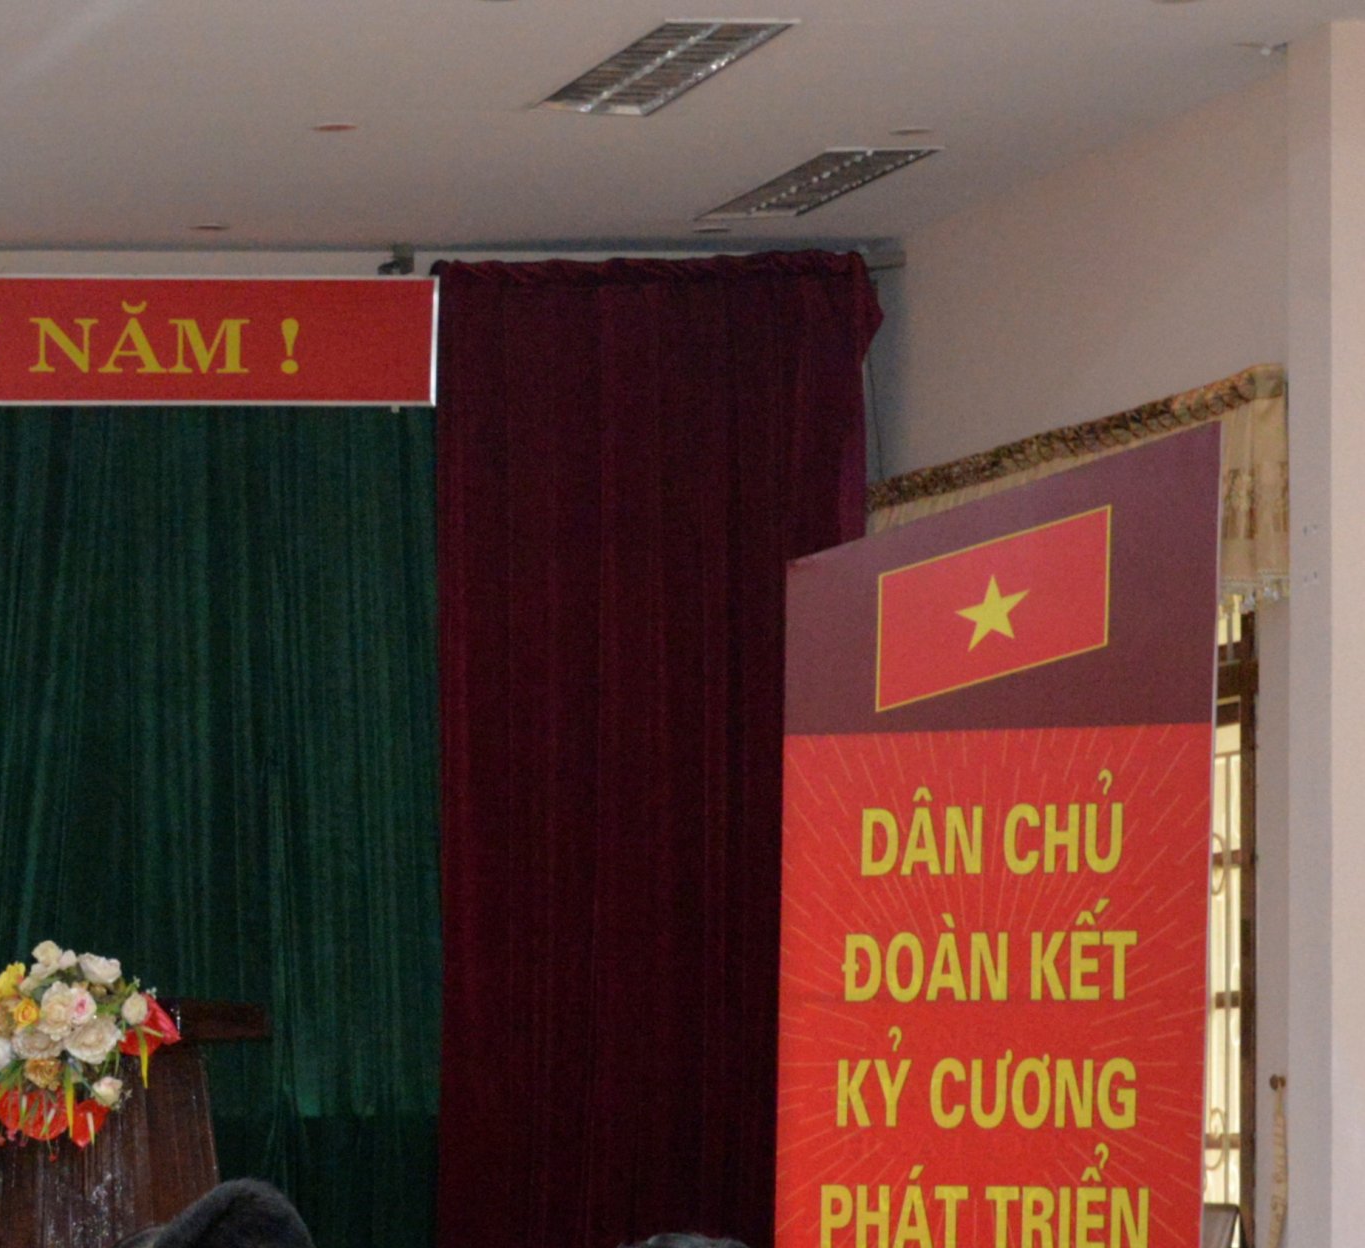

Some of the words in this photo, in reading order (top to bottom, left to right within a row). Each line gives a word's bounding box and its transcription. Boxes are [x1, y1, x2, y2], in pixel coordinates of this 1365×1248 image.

[29, 301, 250, 375] NĂM
[279, 318, 301, 375] !
[860, 787, 984, 878] DÂN
[1003, 769, 1125, 876] CHỦ
[841, 912, 1009, 1003] ĐOÀN
[1029, 899, 1138, 1001] KẾT
[836, 1026, 912, 1129] KỶ
[930, 1051, 1138, 1130] CƯƠNG
